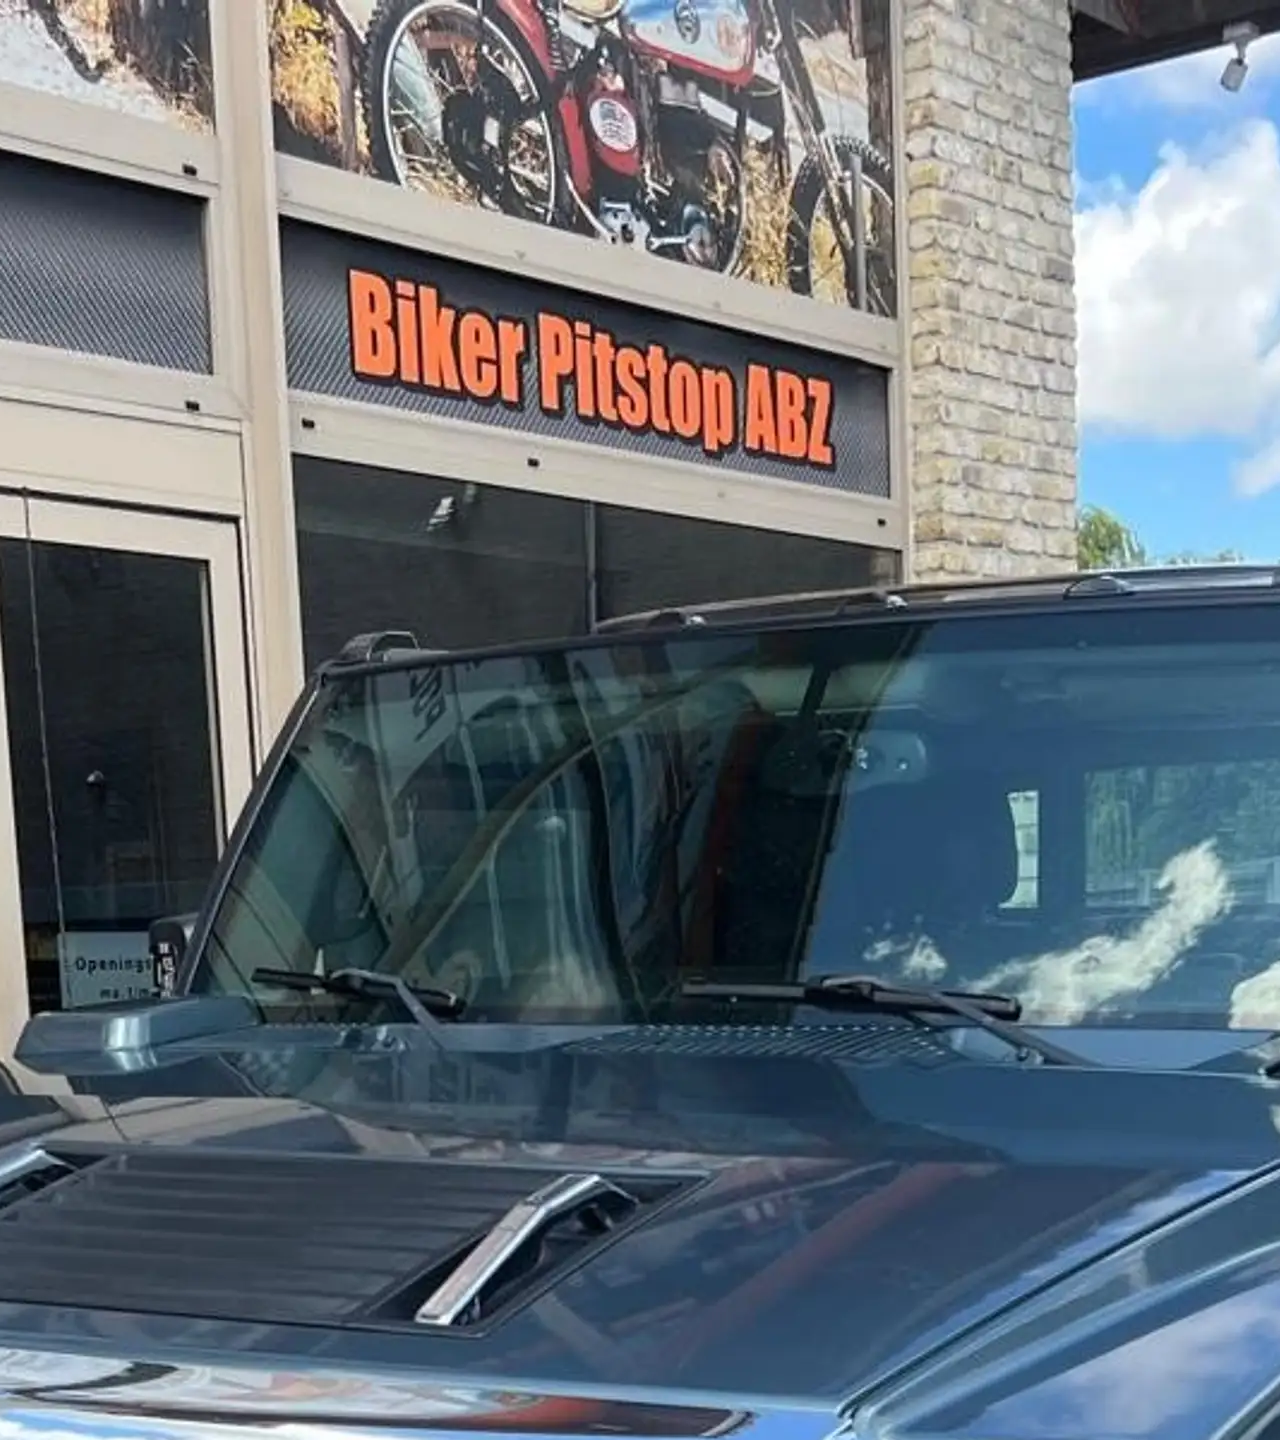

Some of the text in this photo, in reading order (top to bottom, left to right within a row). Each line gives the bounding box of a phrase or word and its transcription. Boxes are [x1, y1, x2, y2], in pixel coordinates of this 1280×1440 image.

[348, 268, 834, 466] Biker Pitstop ABZ
